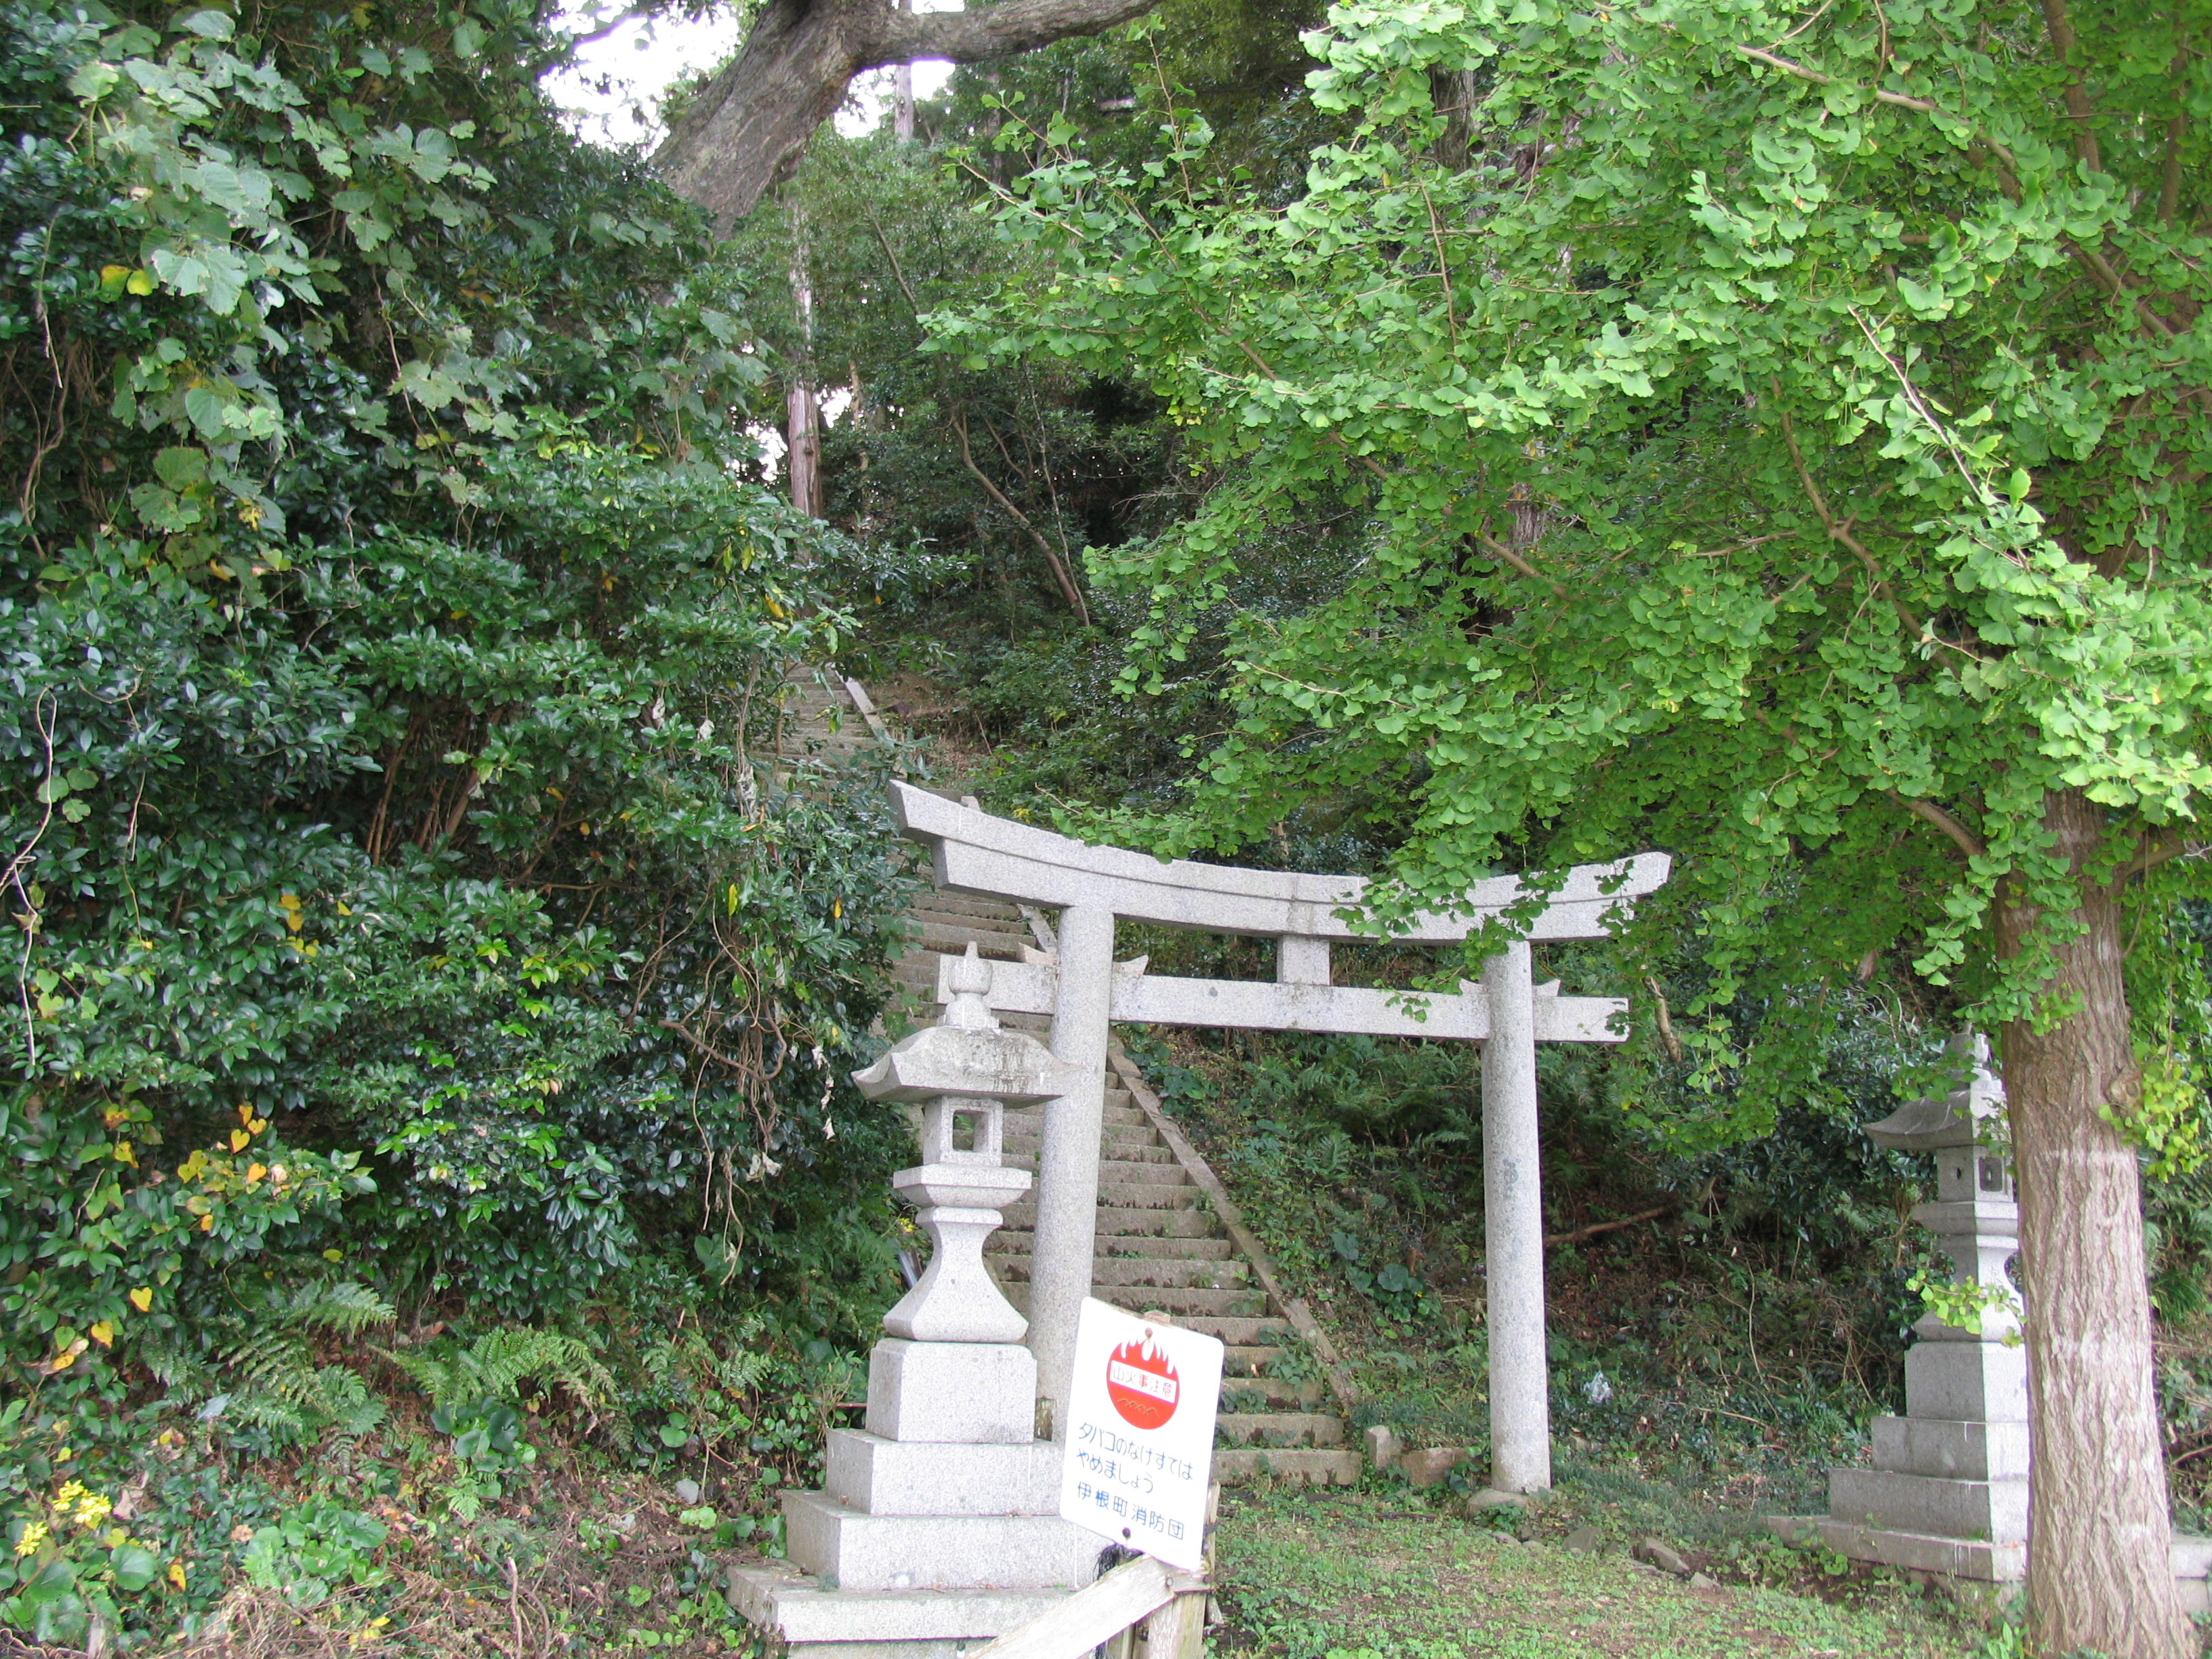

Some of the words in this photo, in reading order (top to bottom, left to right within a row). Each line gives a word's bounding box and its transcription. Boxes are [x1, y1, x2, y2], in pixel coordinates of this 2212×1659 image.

[1113, 1366, 1172, 1397] 山火事注意
[1077, 1449, 1153, 1493] やめましょう
[1079, 1422, 1193, 1479] タバコのなげすては
[1077, 1481, 1184, 1540] 伊根町消防団
